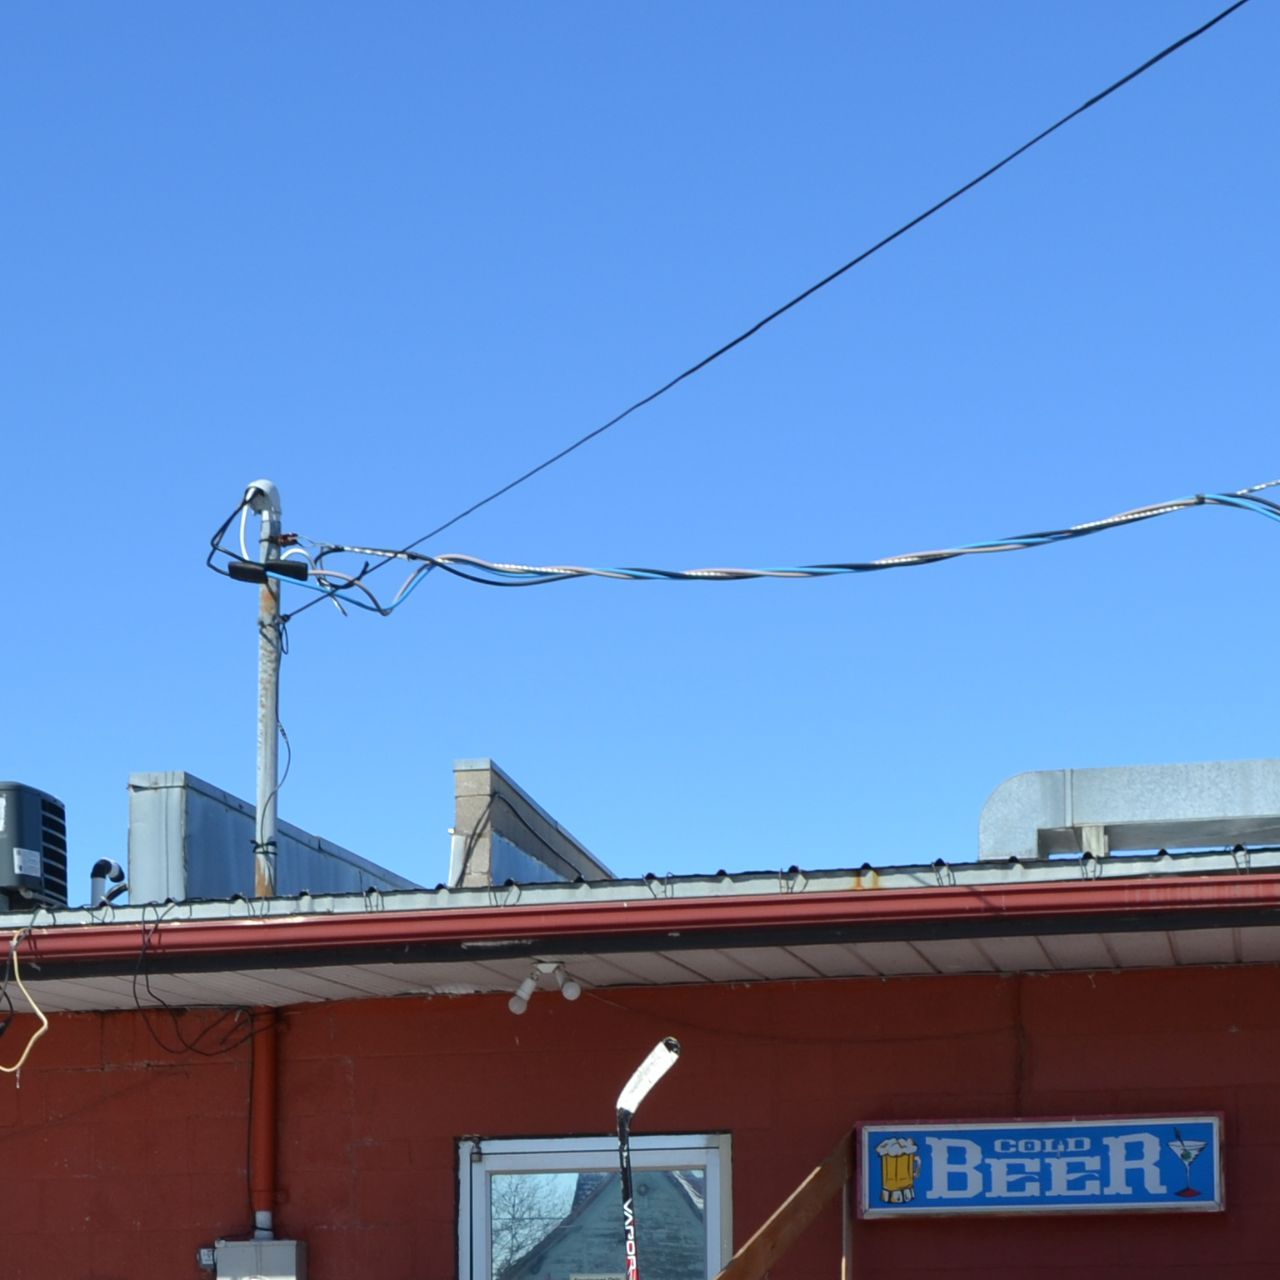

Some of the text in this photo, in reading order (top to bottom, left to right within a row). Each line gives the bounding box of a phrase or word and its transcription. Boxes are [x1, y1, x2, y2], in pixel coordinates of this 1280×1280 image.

[925, 1132, 1168, 1200] BEER
[993, 1137, 1091, 1153] COLD
[623, 1198, 637, 1275] VAPOR
